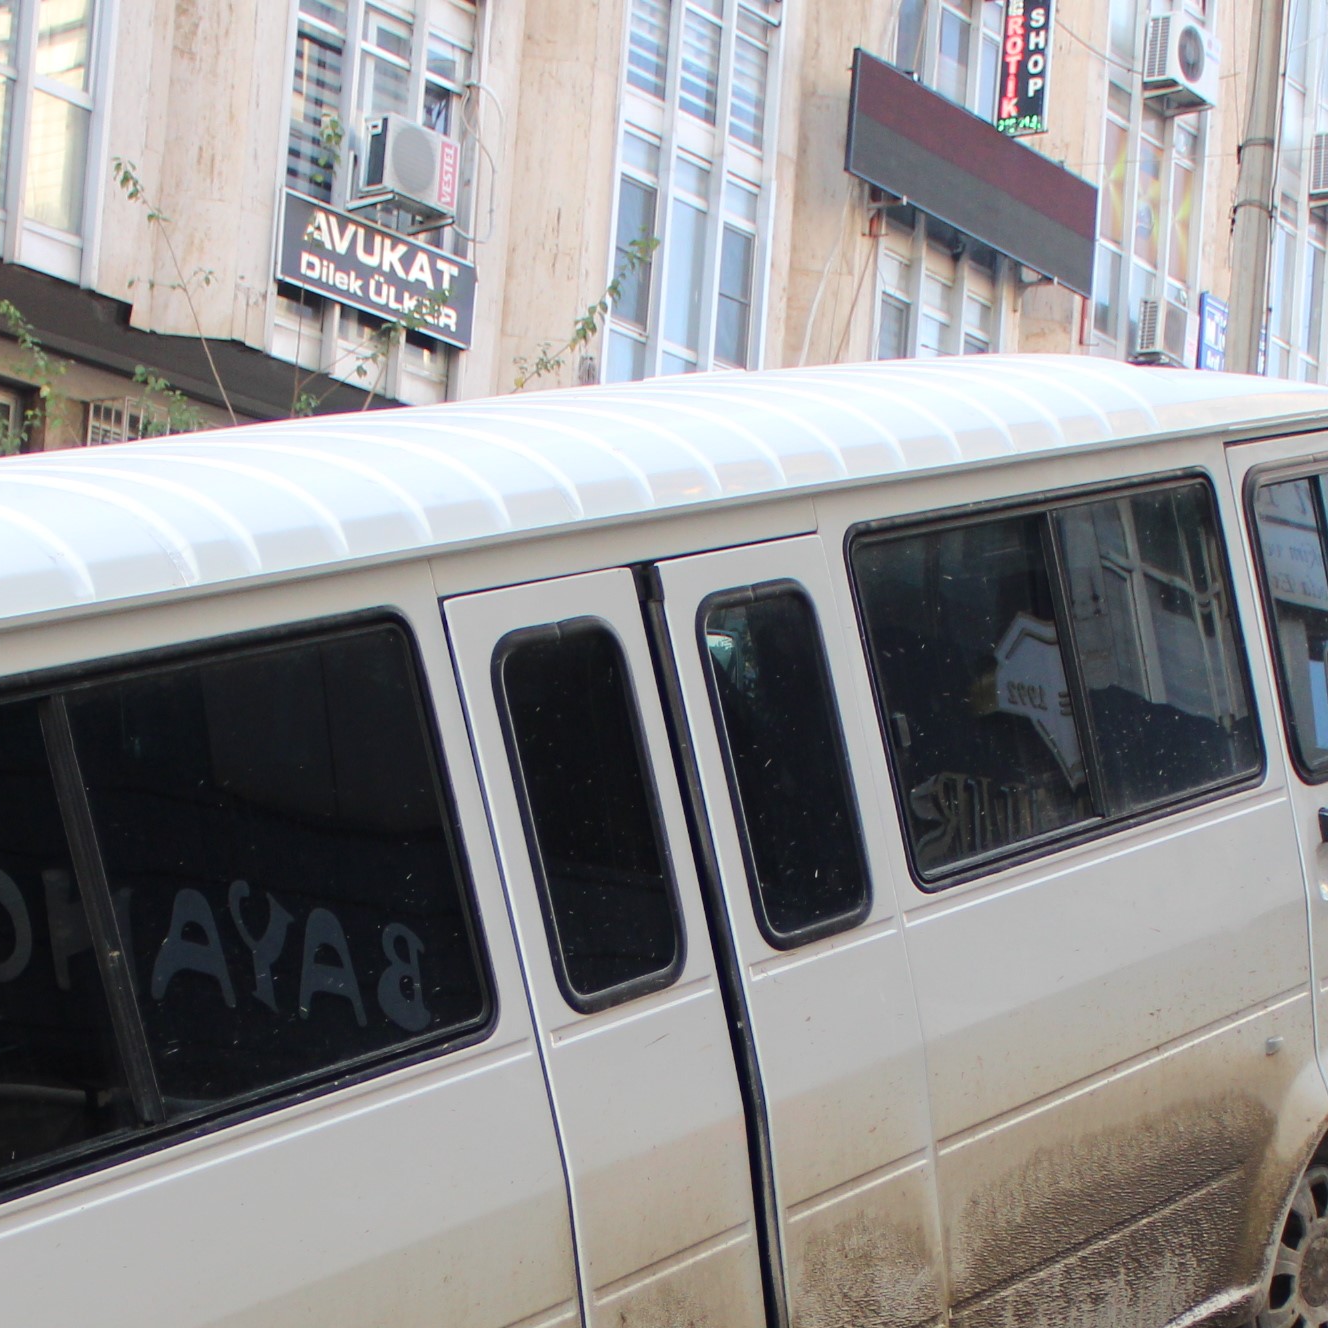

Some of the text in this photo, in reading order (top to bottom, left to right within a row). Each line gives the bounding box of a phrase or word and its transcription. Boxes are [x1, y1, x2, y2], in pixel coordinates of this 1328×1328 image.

[1027, 8, 1046, 97] SHOP
[439, 145, 458, 208] VESTEL
[300, 251, 364, 297] Dilek
[303, 209, 460, 296] AVUKAT
